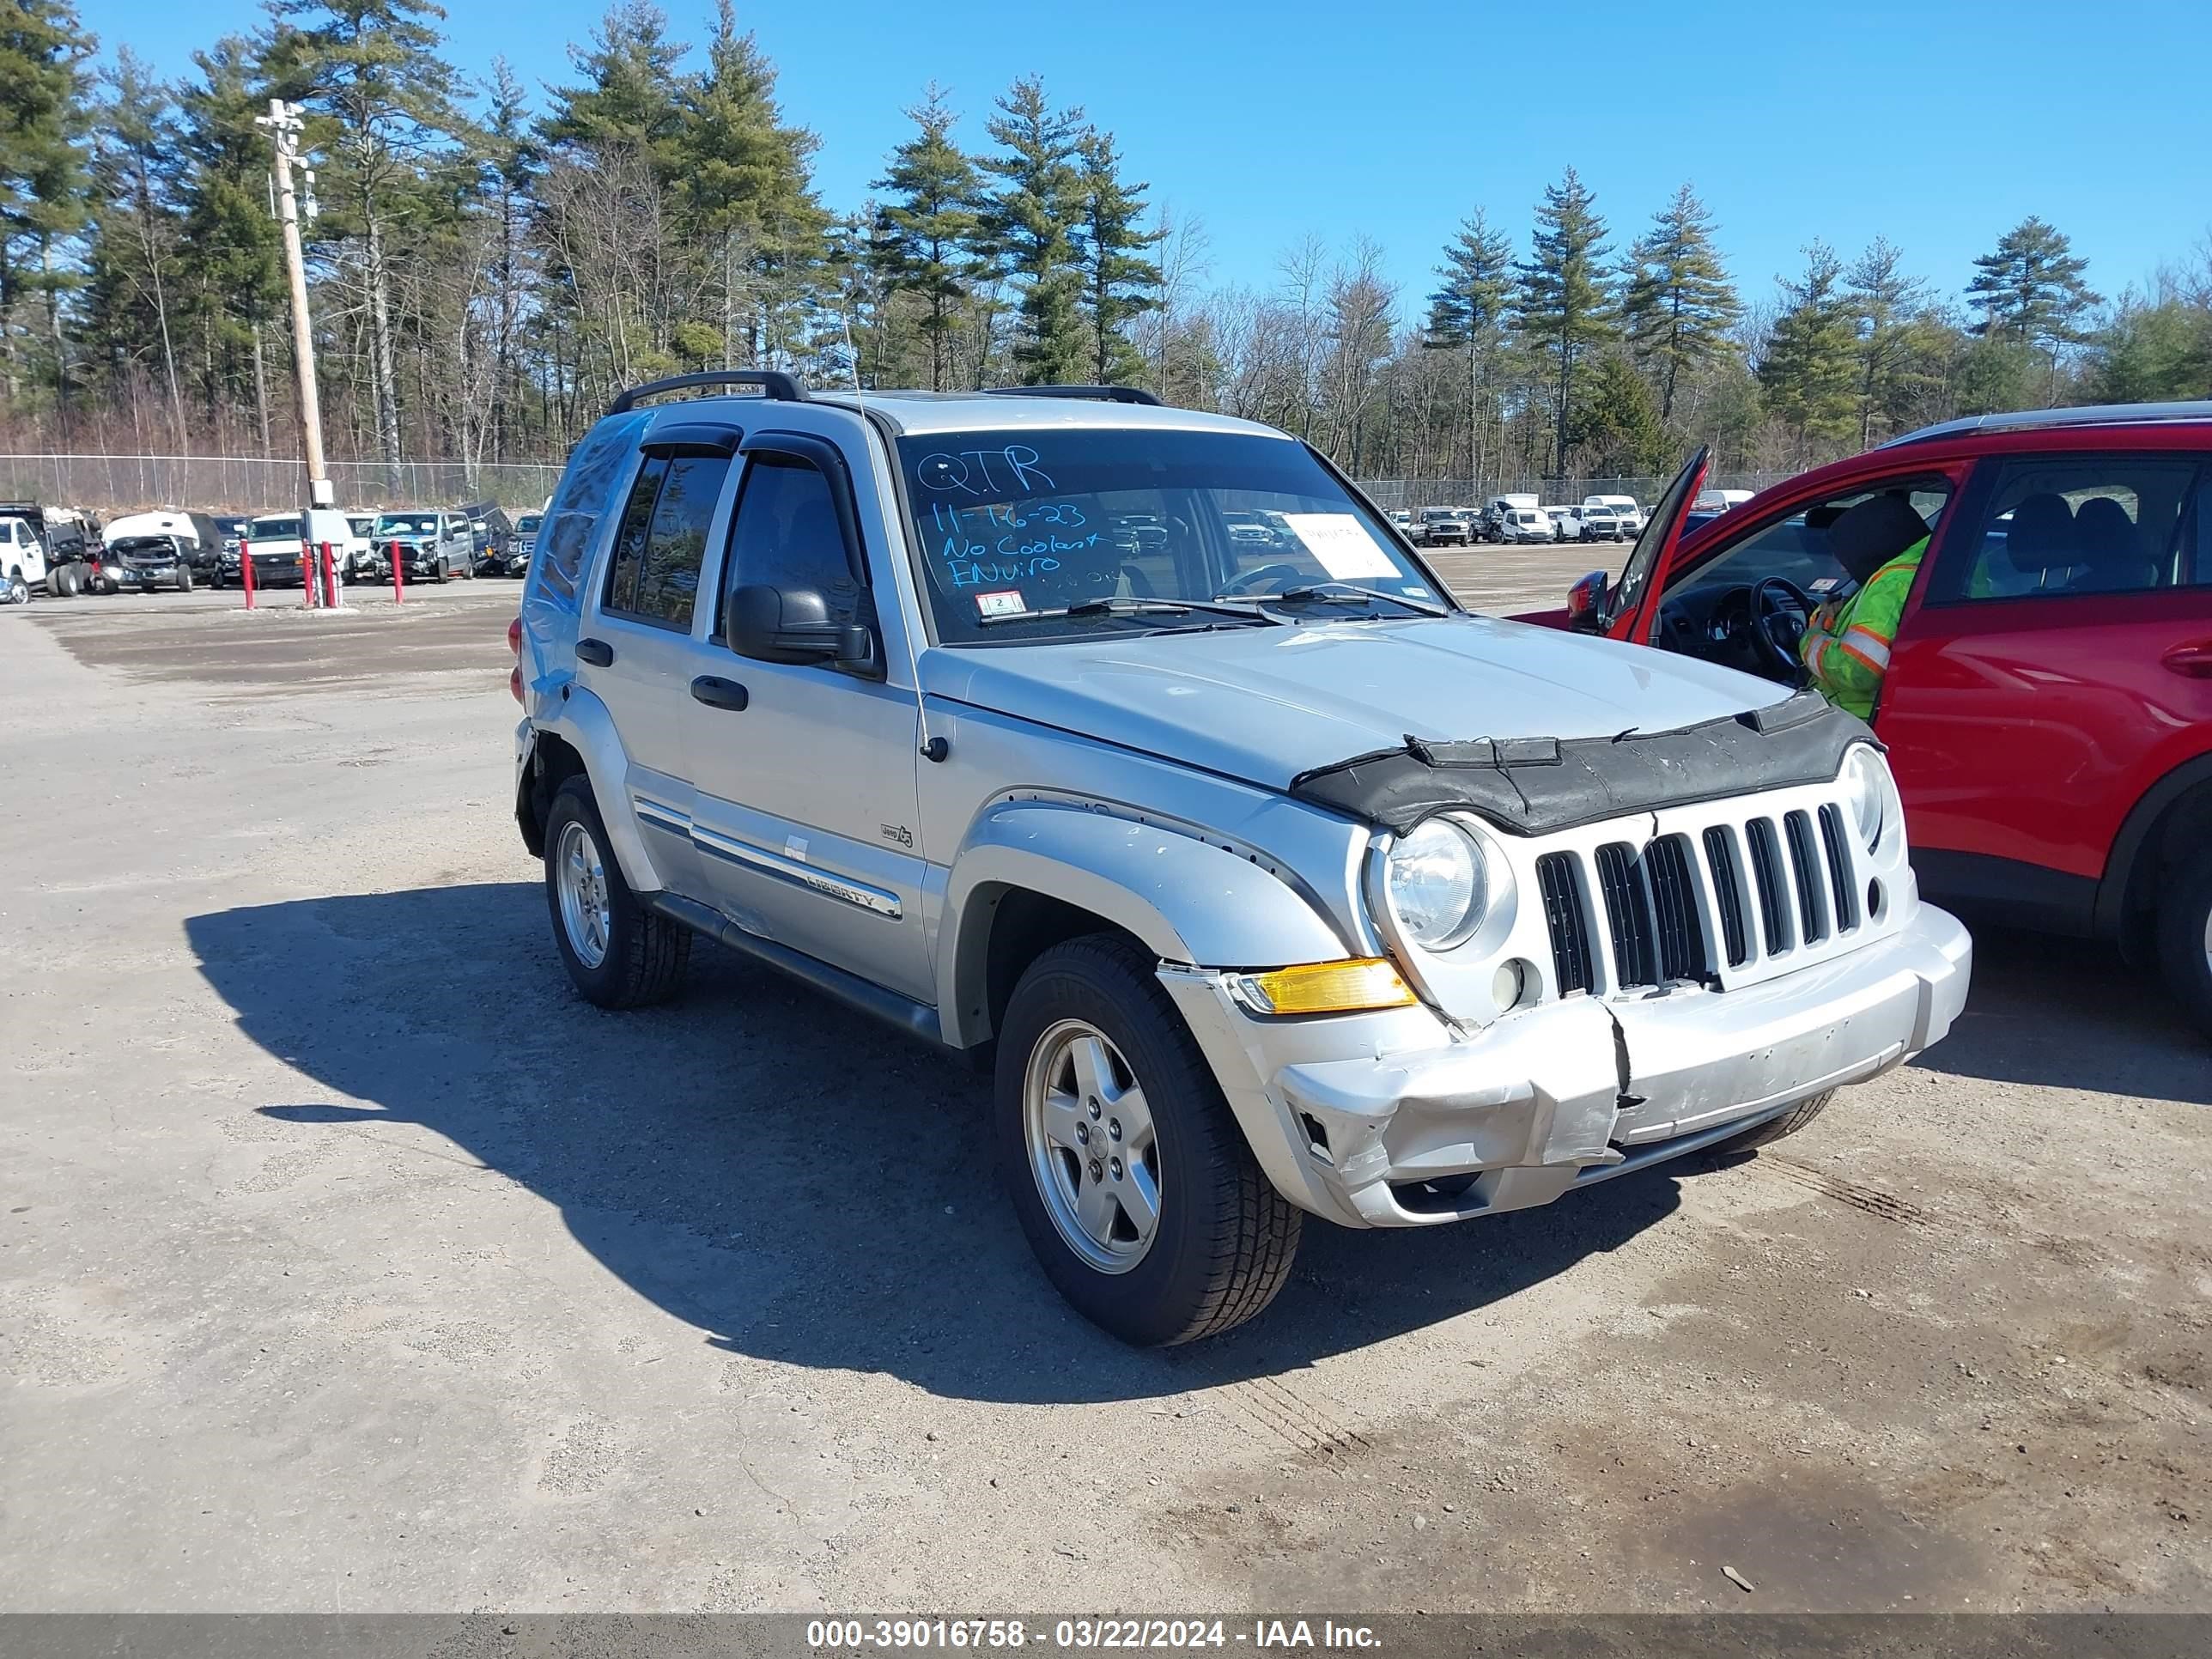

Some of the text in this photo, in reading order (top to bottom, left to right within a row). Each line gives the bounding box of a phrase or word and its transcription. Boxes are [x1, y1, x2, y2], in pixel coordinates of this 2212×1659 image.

[918, 445, 1055, 495] QTR
[933, 502, 1086, 533] 11-16-23
[944, 538, 986, 557] No
[882, 827, 898, 839] Jeep
[807, 876, 875, 907] LIBERTY
